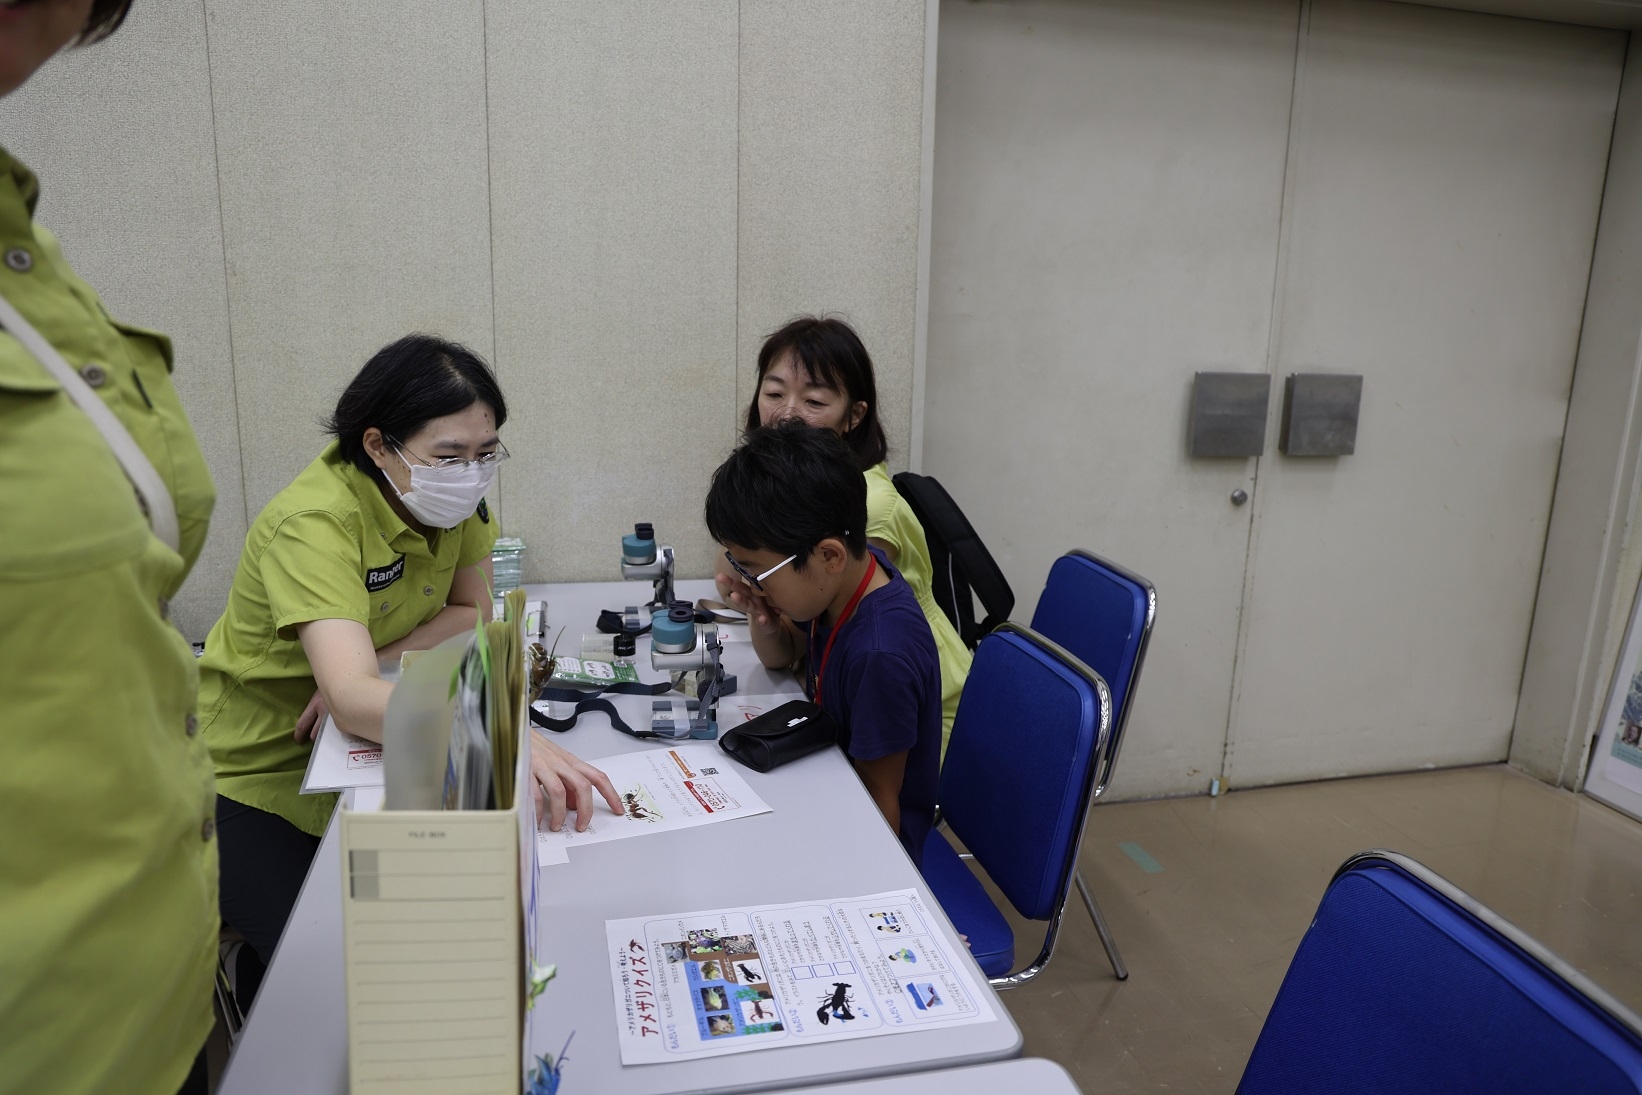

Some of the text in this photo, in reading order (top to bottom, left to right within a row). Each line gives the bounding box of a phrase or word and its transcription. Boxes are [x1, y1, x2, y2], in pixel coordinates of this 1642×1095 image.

[628, 954, 659, 1037] アメザリクイズ
